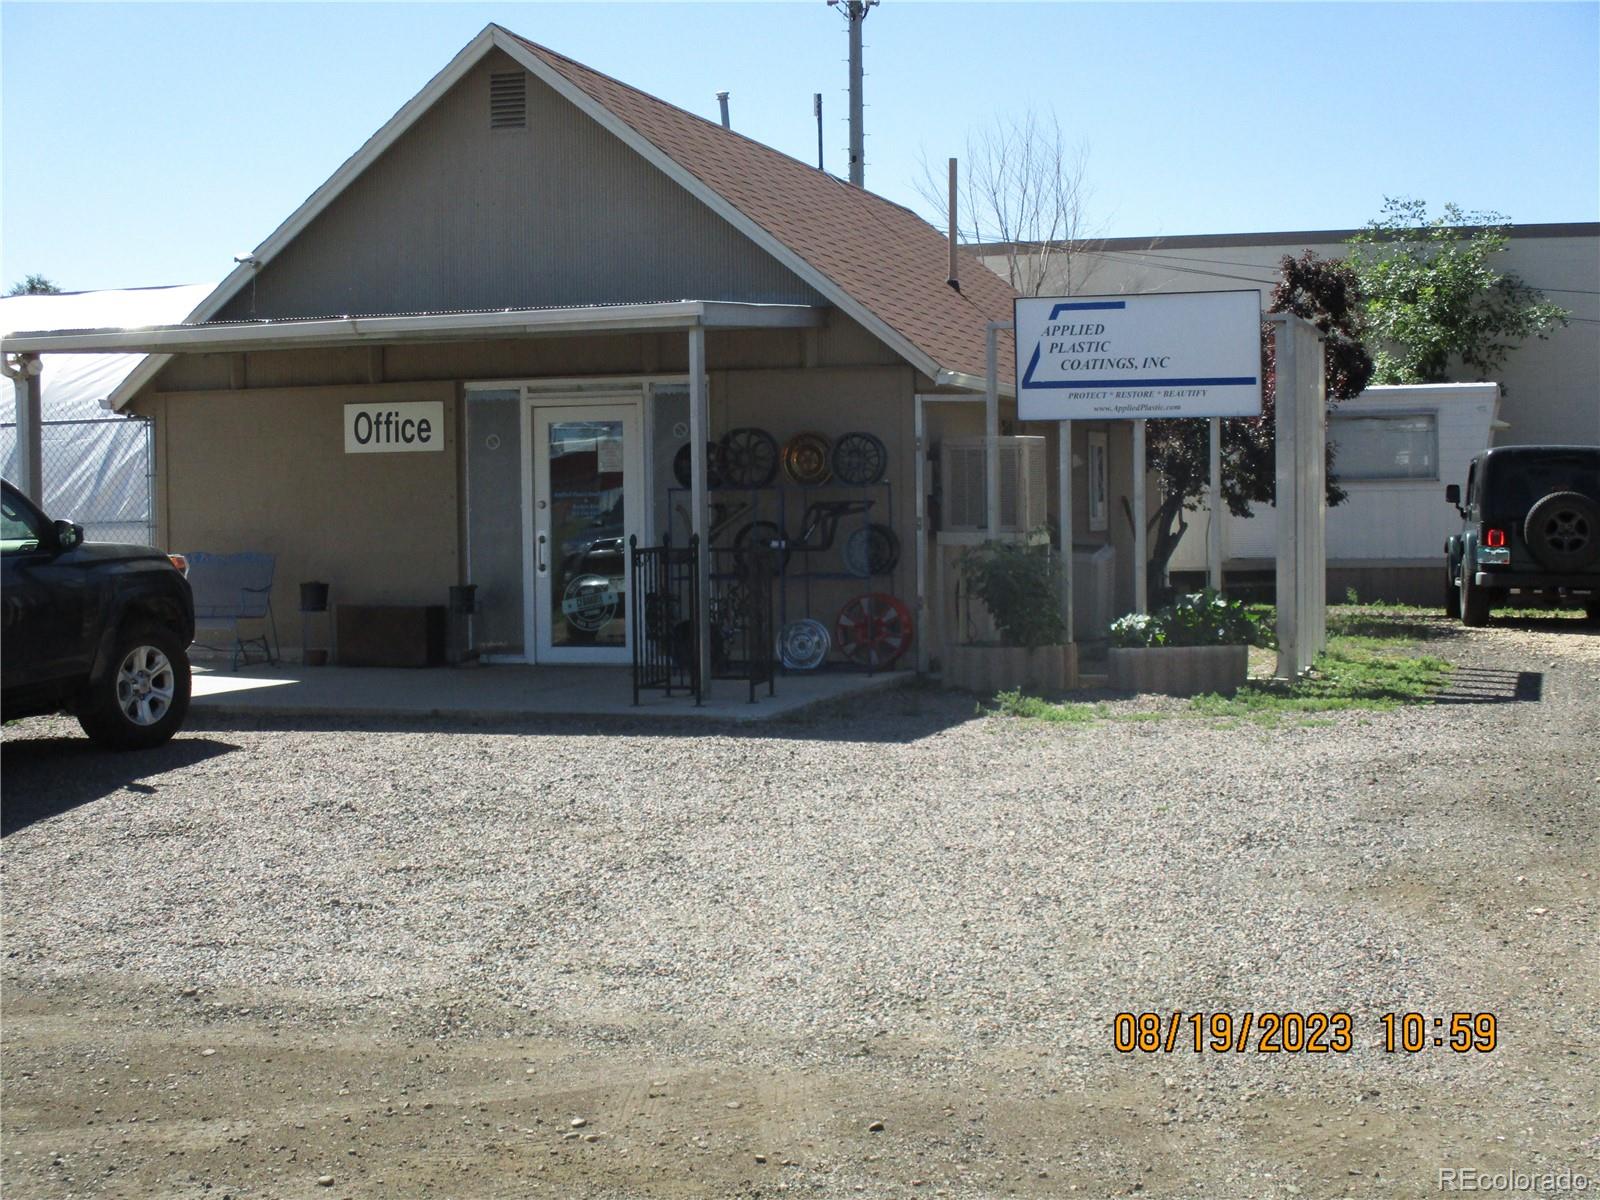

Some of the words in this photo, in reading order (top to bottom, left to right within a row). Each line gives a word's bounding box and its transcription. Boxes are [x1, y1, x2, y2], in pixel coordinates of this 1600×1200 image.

[1041, 323, 1105, 337] APPLIED
[1049, 340, 1111, 354] PLASTIC
[1060, 357, 1139, 371] COATINGS,
[1142, 356, 1171, 369] INC
[1068, 391, 1108, 400] PROTECT
[1115, 390, 1154, 399] RESTORE
[1163, 389, 1209, 398] BEAUTIFY
[354, 411, 432, 445] Office
